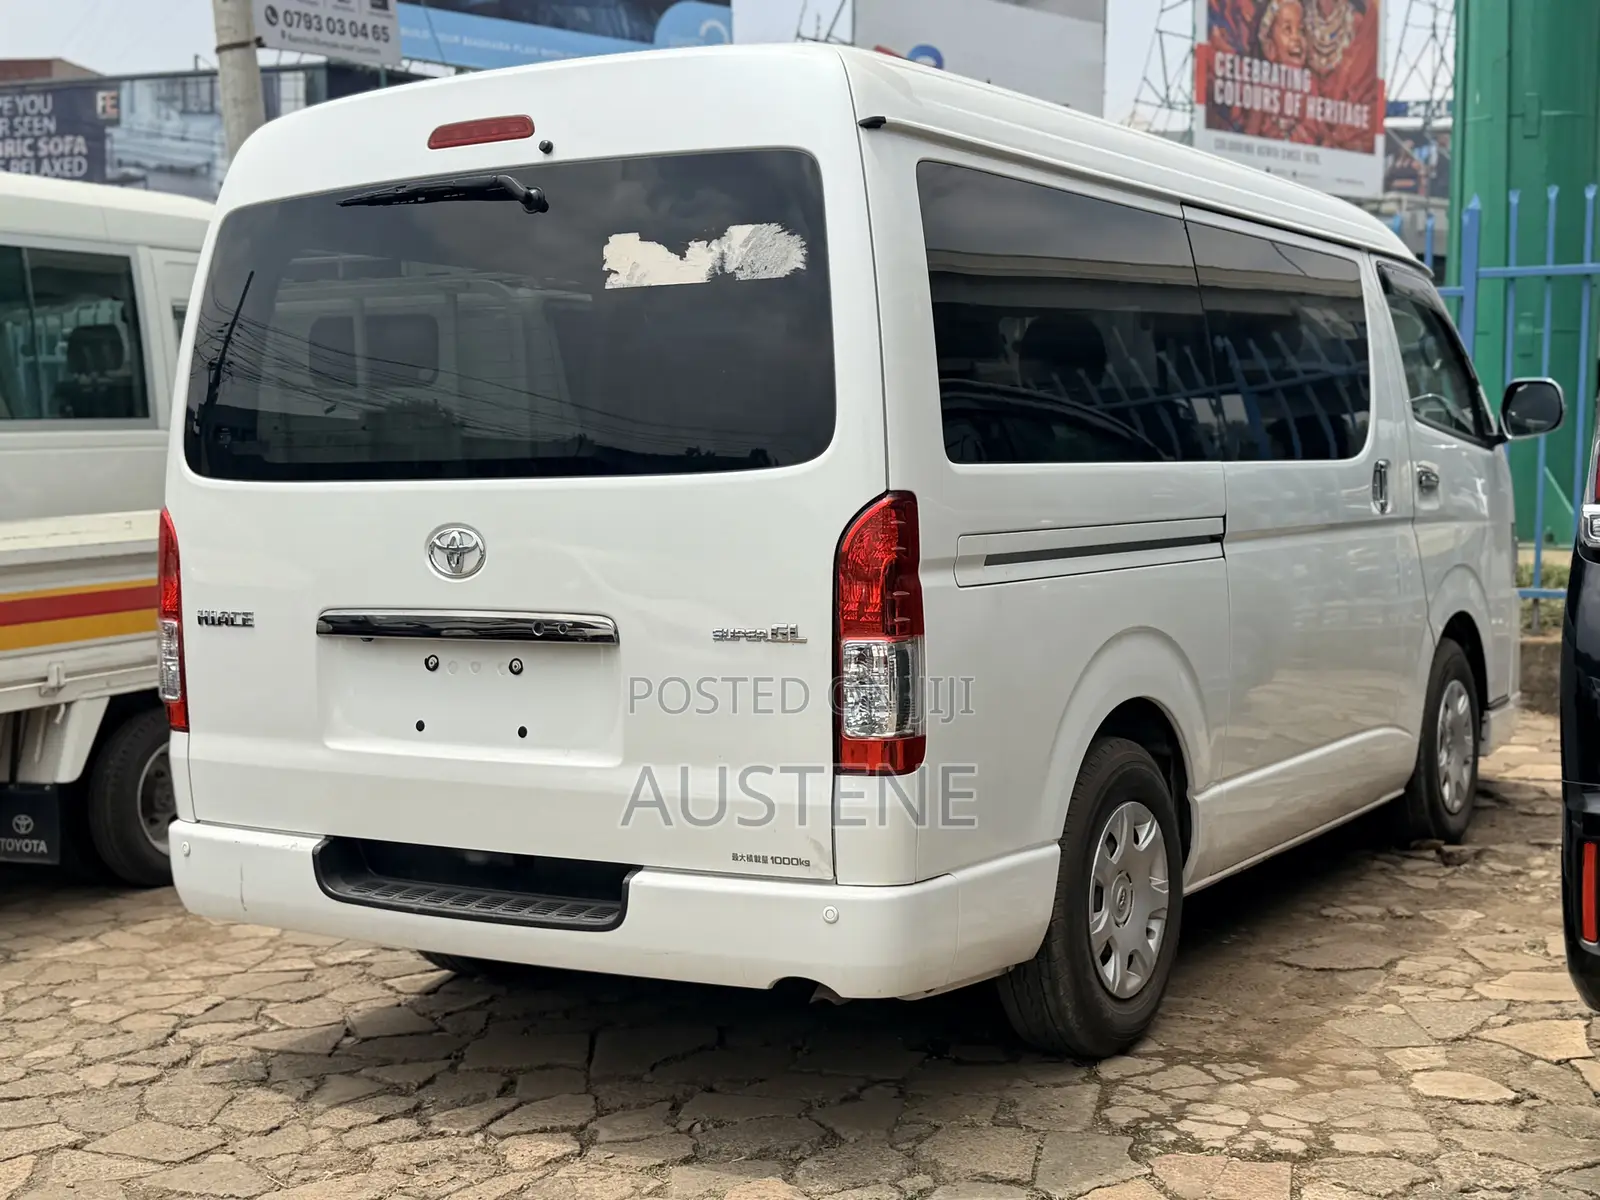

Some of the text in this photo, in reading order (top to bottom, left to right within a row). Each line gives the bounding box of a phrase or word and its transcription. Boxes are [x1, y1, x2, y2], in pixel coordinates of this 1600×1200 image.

[326, 16, 347, 36] 03
[349, 20, 369, 39] 04
[371, 24, 390, 43] 65
[1213, 51, 1312, 93] CELEBRATING
[15, 93, 53, 115] YOU
[1213, 78, 1281, 115] COLOURS
[1283, 91, 1303, 118] OF
[1306, 95, 1371, 130] HERITAGE
[13, 115, 57, 137] SEEN
[0, 135, 88, 158] RIC SOFA
[197, 609, 255, 628] HIACE
[0, 838, 48, 854] TOYOTA
